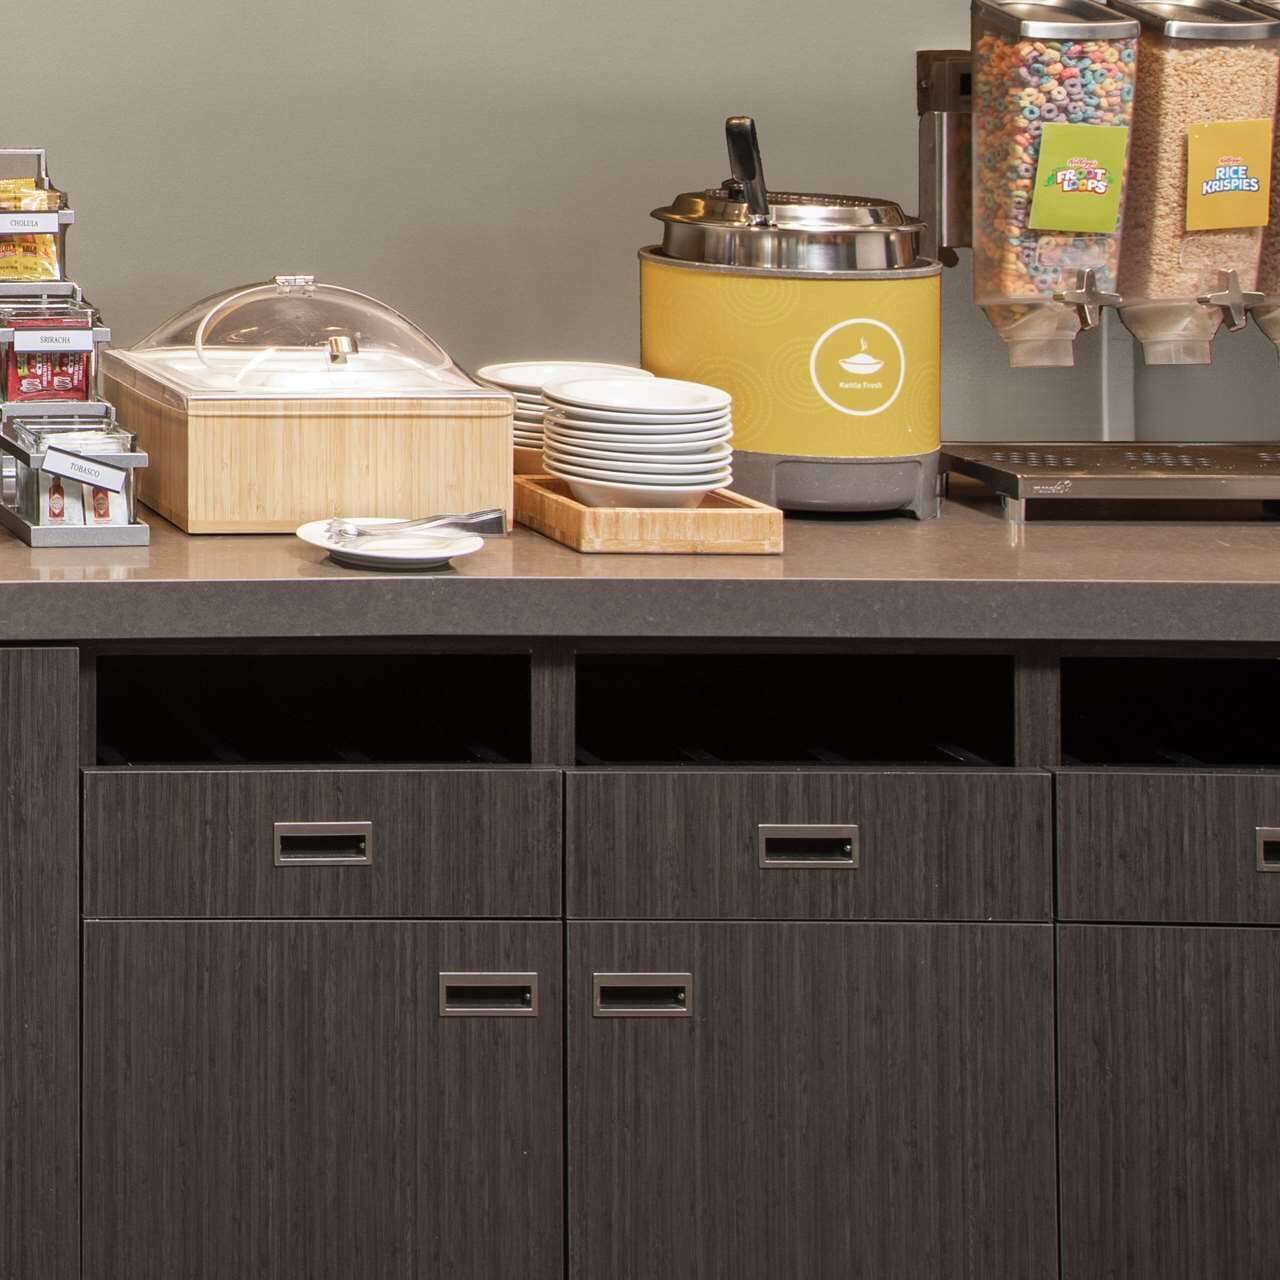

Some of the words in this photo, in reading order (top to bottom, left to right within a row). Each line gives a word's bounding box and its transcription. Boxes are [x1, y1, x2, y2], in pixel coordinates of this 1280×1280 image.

[1215, 165, 1248, 180] RICE
[1062, 179, 1108, 195] LOOPS
[1201, 178, 1260, 196] KRISPIES
